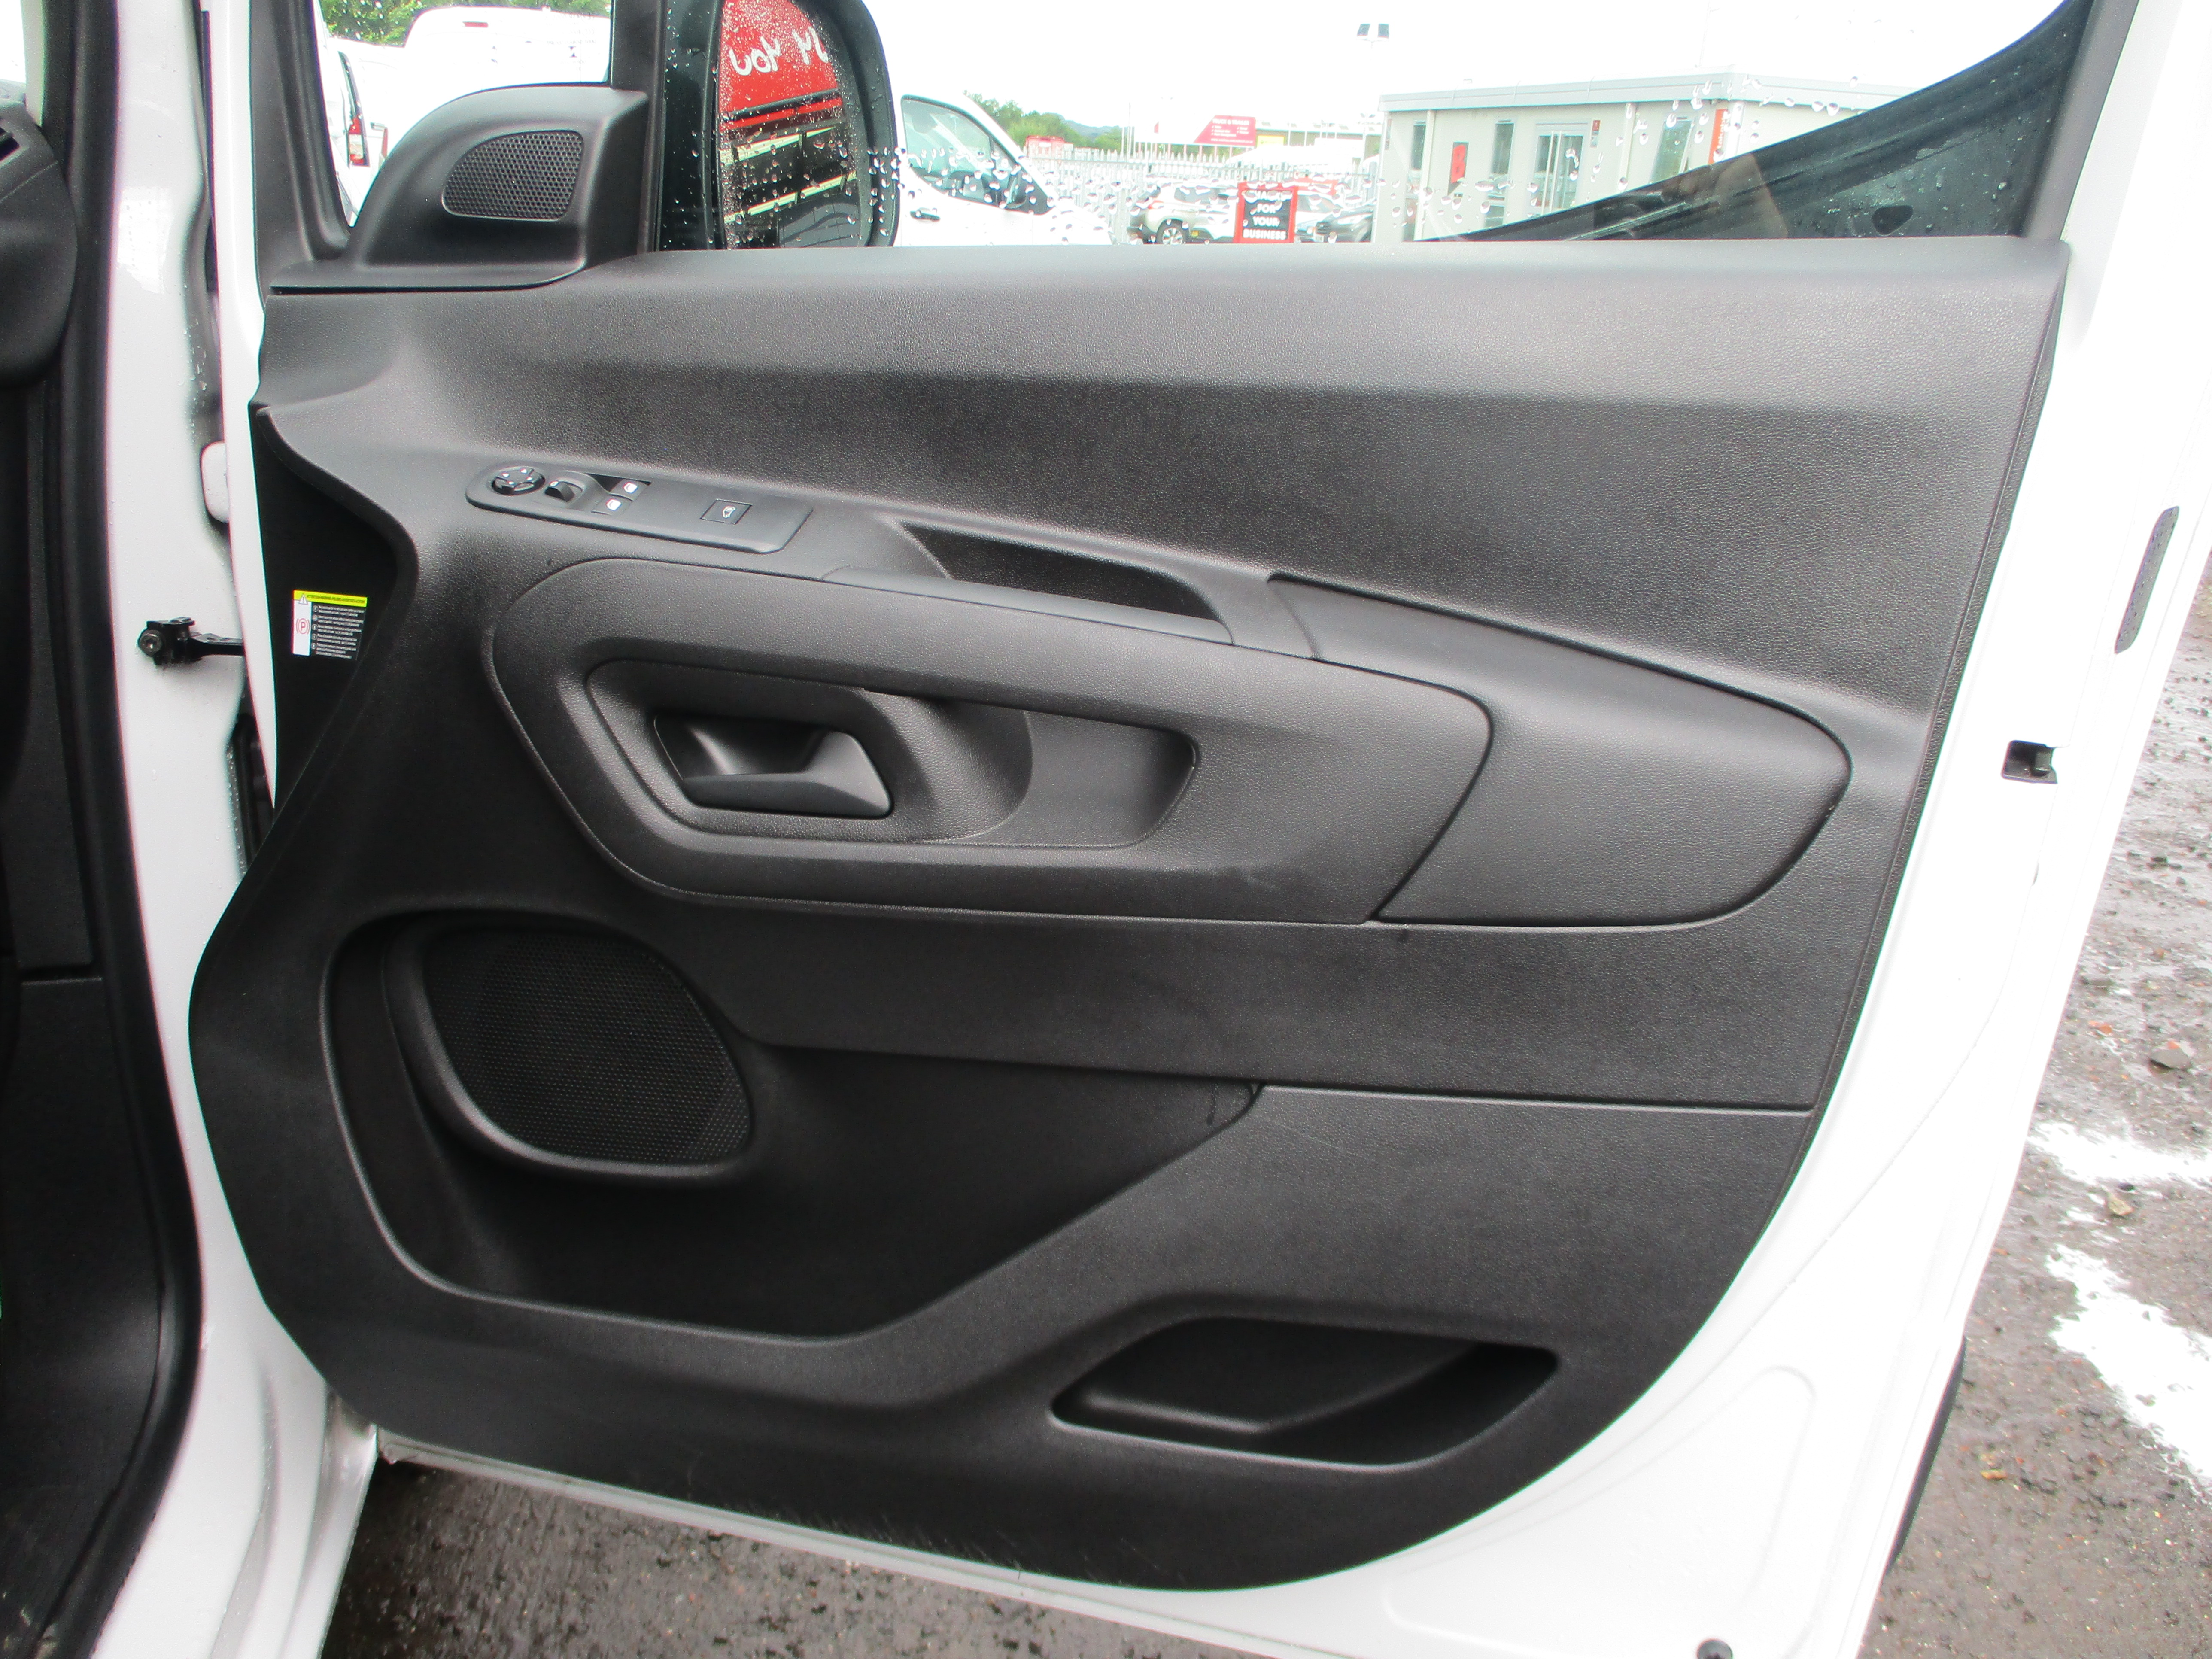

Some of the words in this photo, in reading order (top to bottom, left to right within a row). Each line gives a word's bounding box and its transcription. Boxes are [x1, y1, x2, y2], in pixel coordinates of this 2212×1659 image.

[1257, 203, 1276, 213] FOR
[1252, 216, 1279, 227] YOUR
[1243, 228, 1287, 240] BUSINESS
